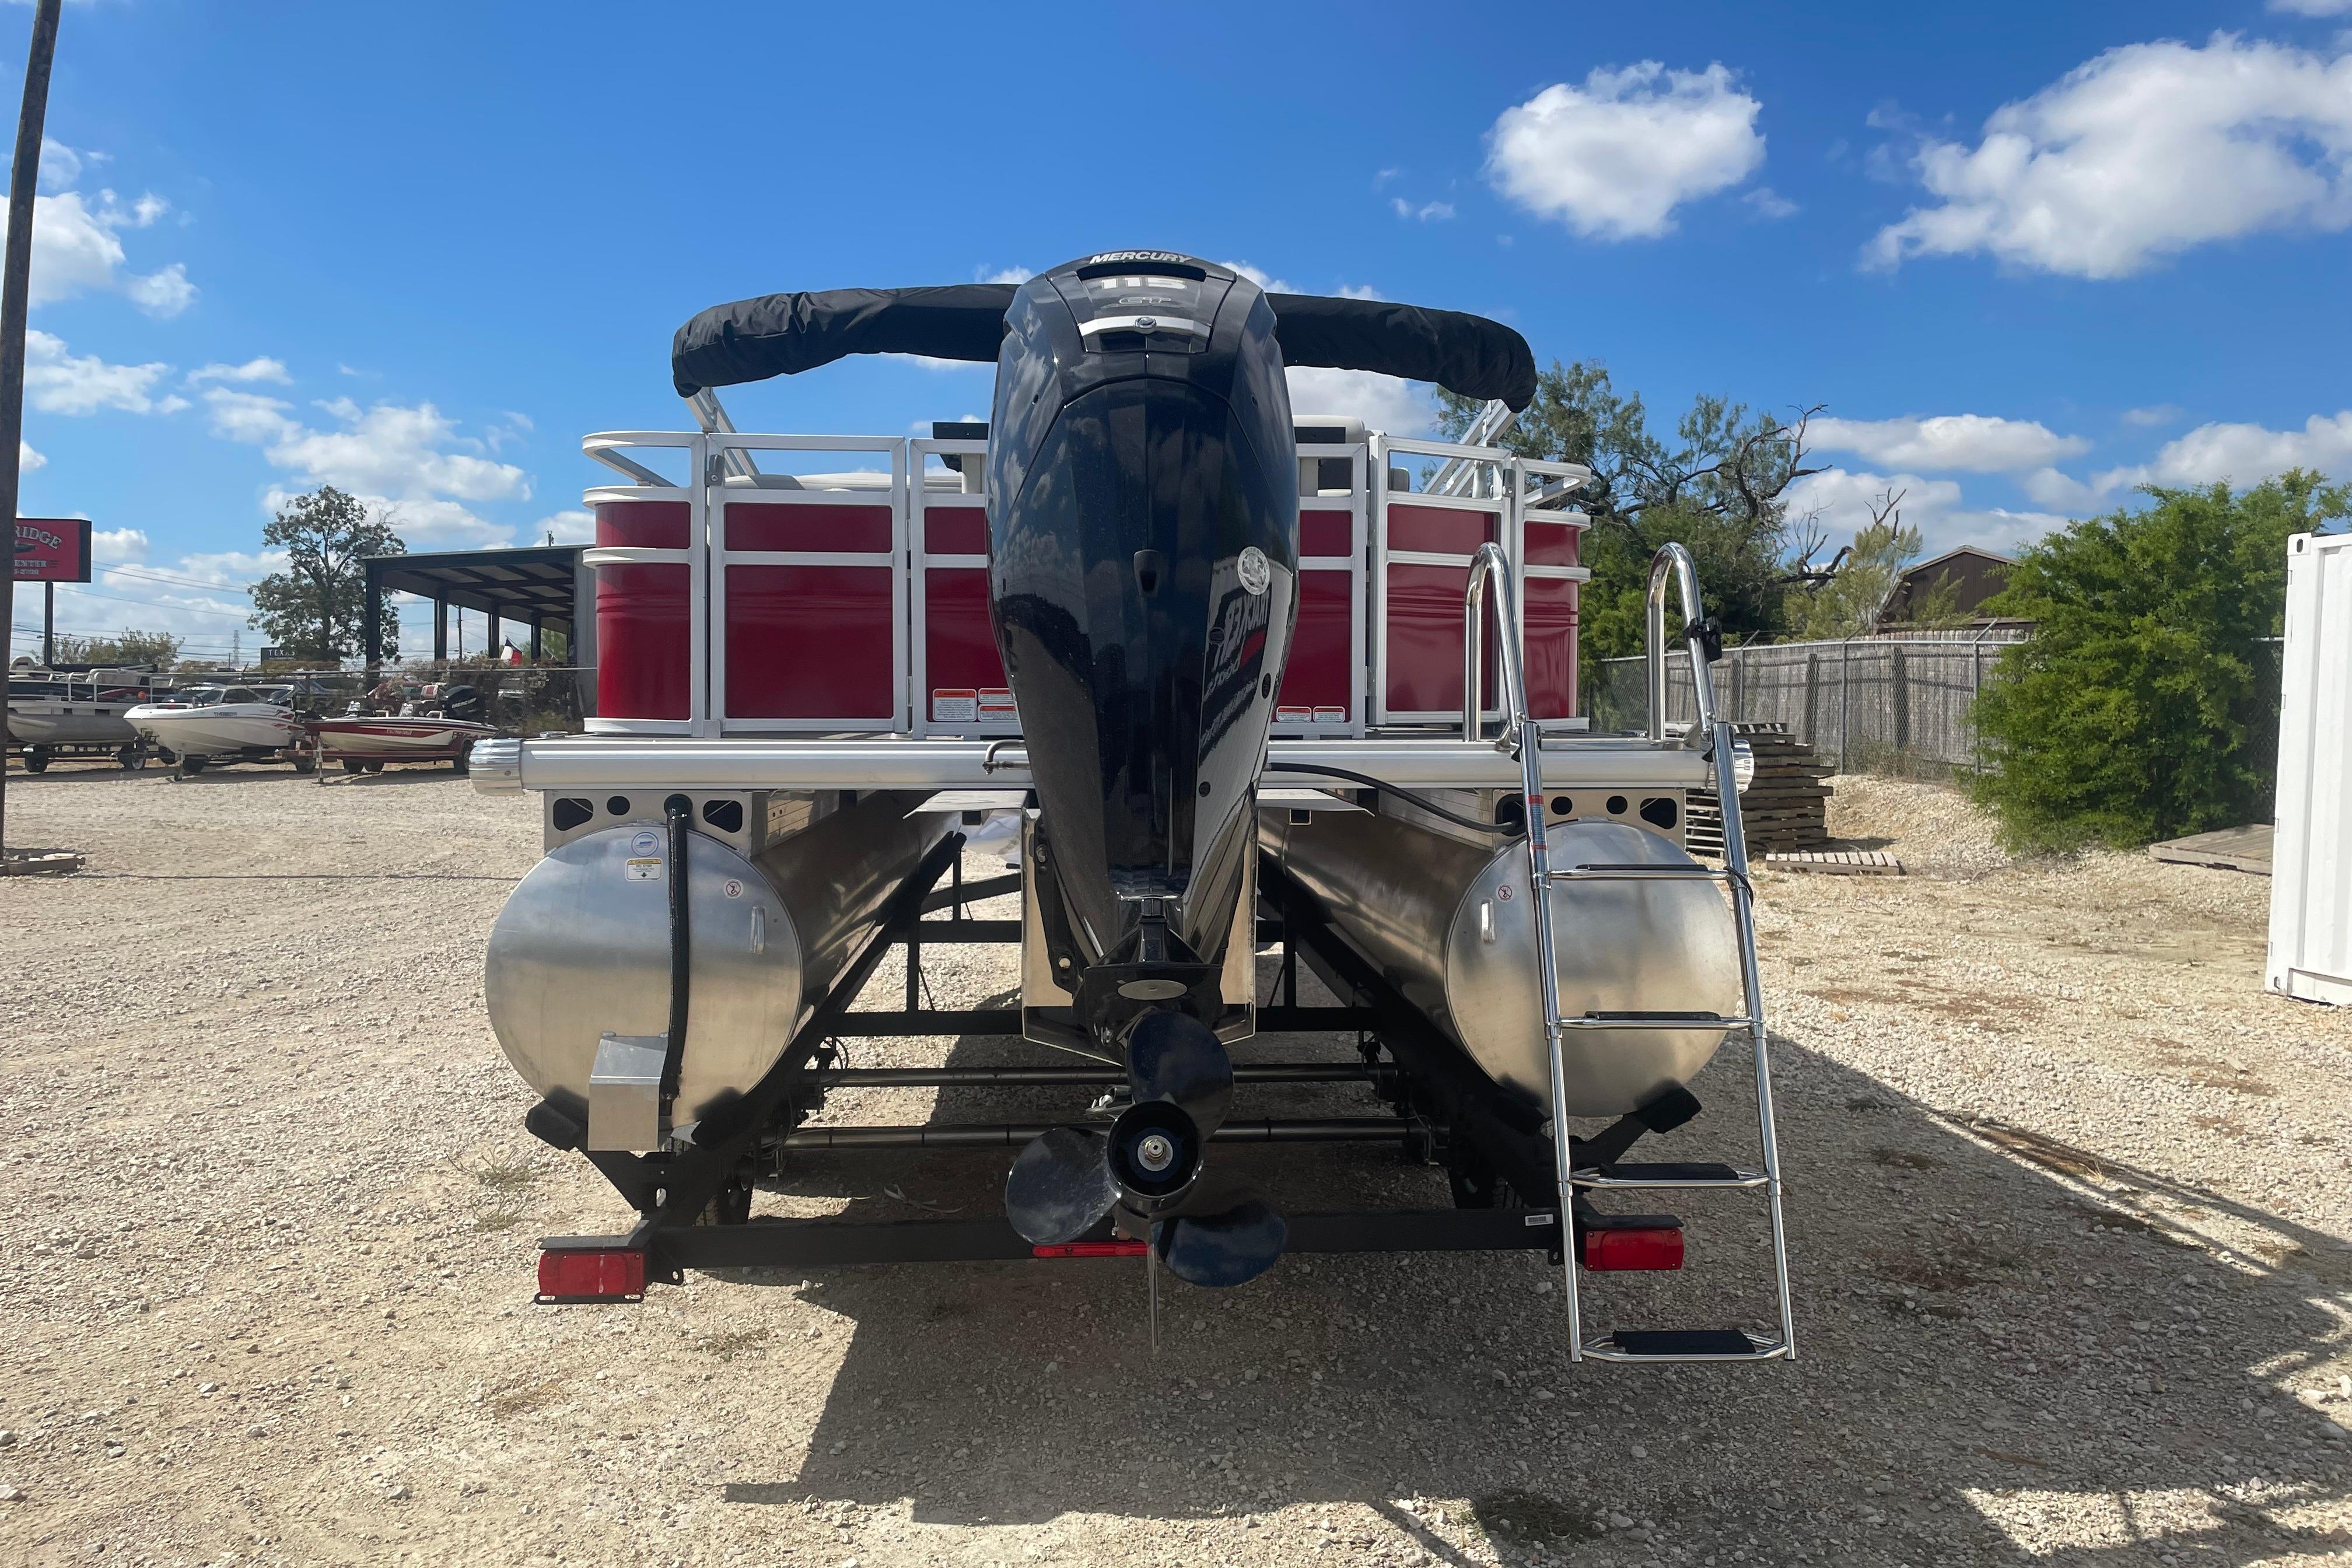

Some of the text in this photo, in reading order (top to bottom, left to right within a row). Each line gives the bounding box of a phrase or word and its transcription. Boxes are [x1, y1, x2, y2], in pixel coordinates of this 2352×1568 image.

[1089, 251, 1193, 264] MERCURY
[1101, 276, 1187, 289] 115
[14, 559, 47, 568] ENTER
